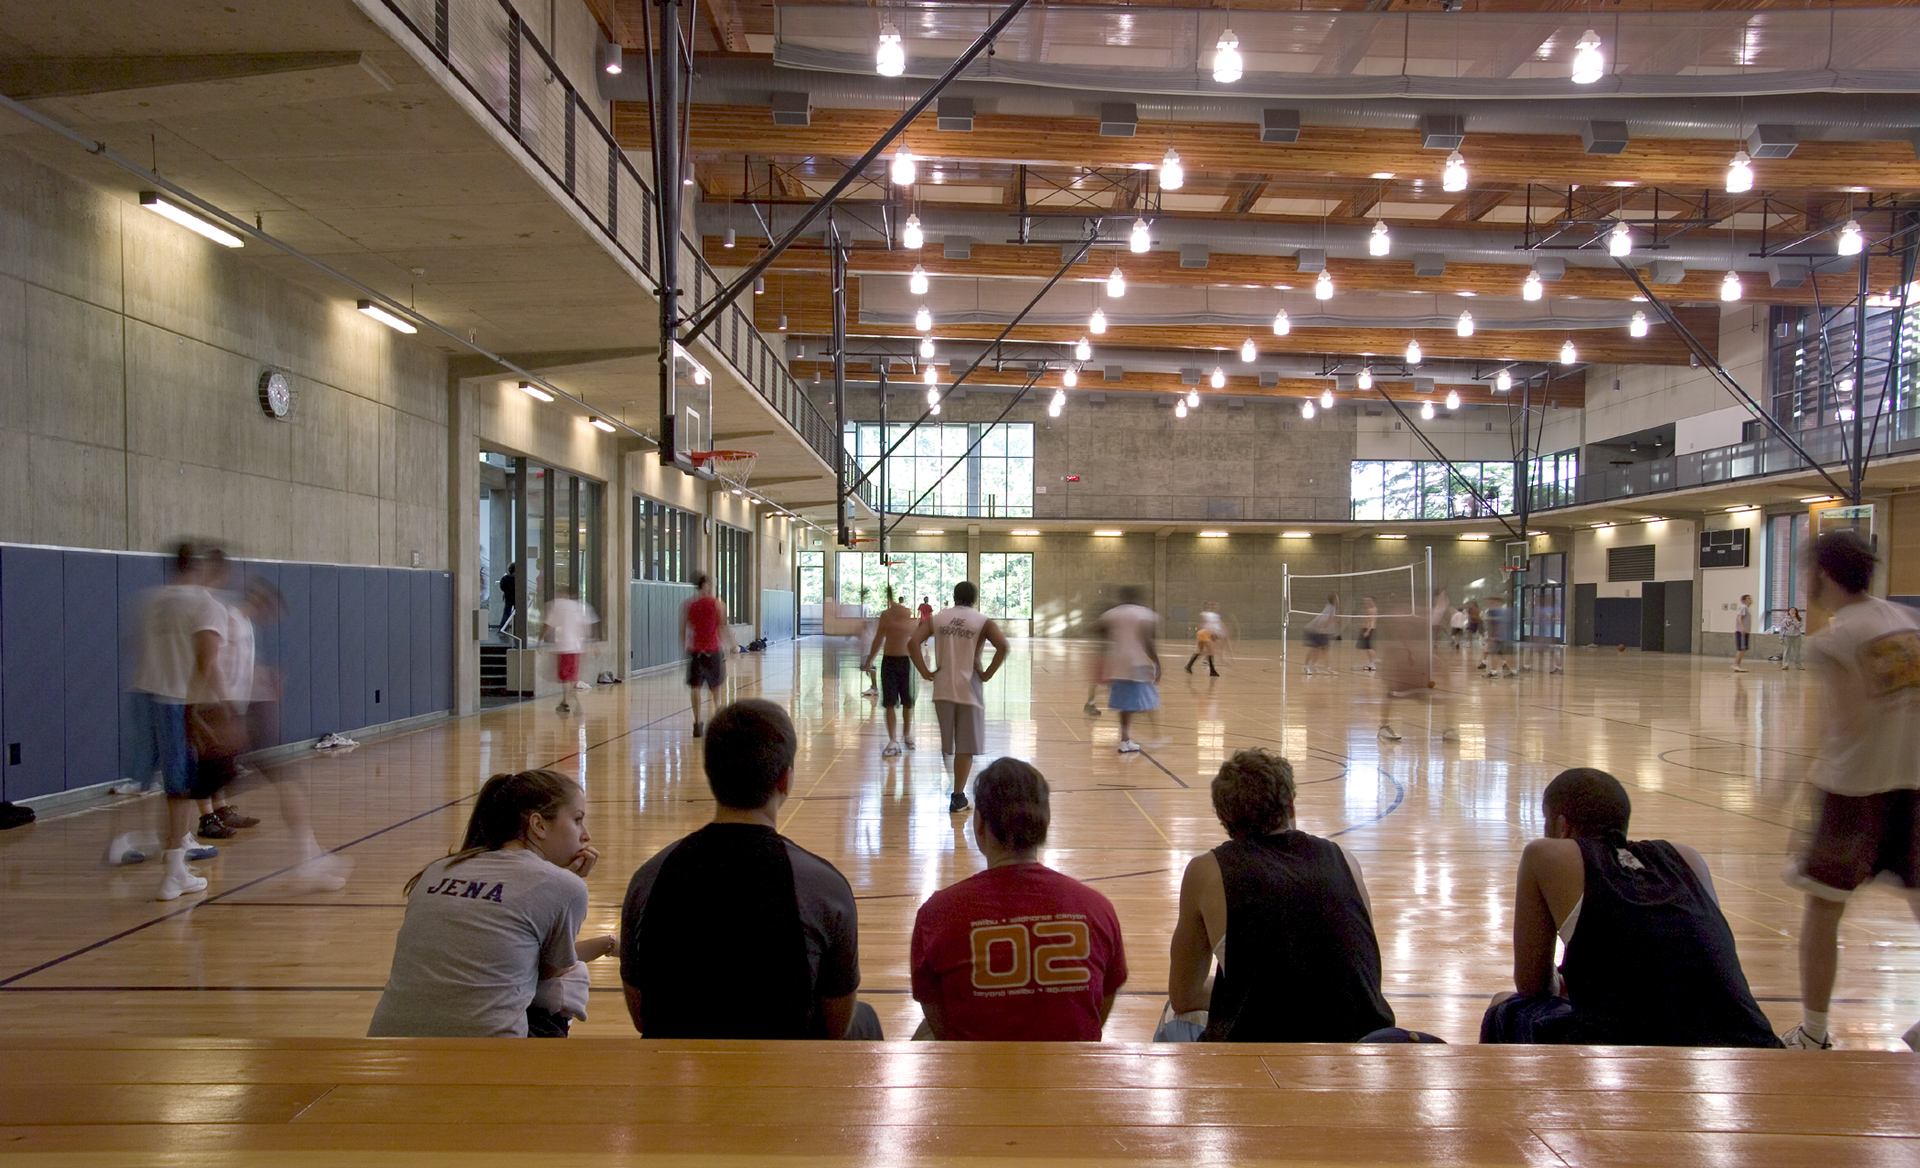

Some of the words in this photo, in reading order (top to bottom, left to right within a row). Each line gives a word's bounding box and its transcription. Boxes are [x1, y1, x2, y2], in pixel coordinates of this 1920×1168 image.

[427, 878, 504, 903] JENA
[970, 919, 998, 928] malibu
[1009, 915, 1052, 923] wildhorse
[1055, 913, 1087, 921] canyon
[970, 921, 1091, 989] 02
[973, 989, 1006, 998] beyond
